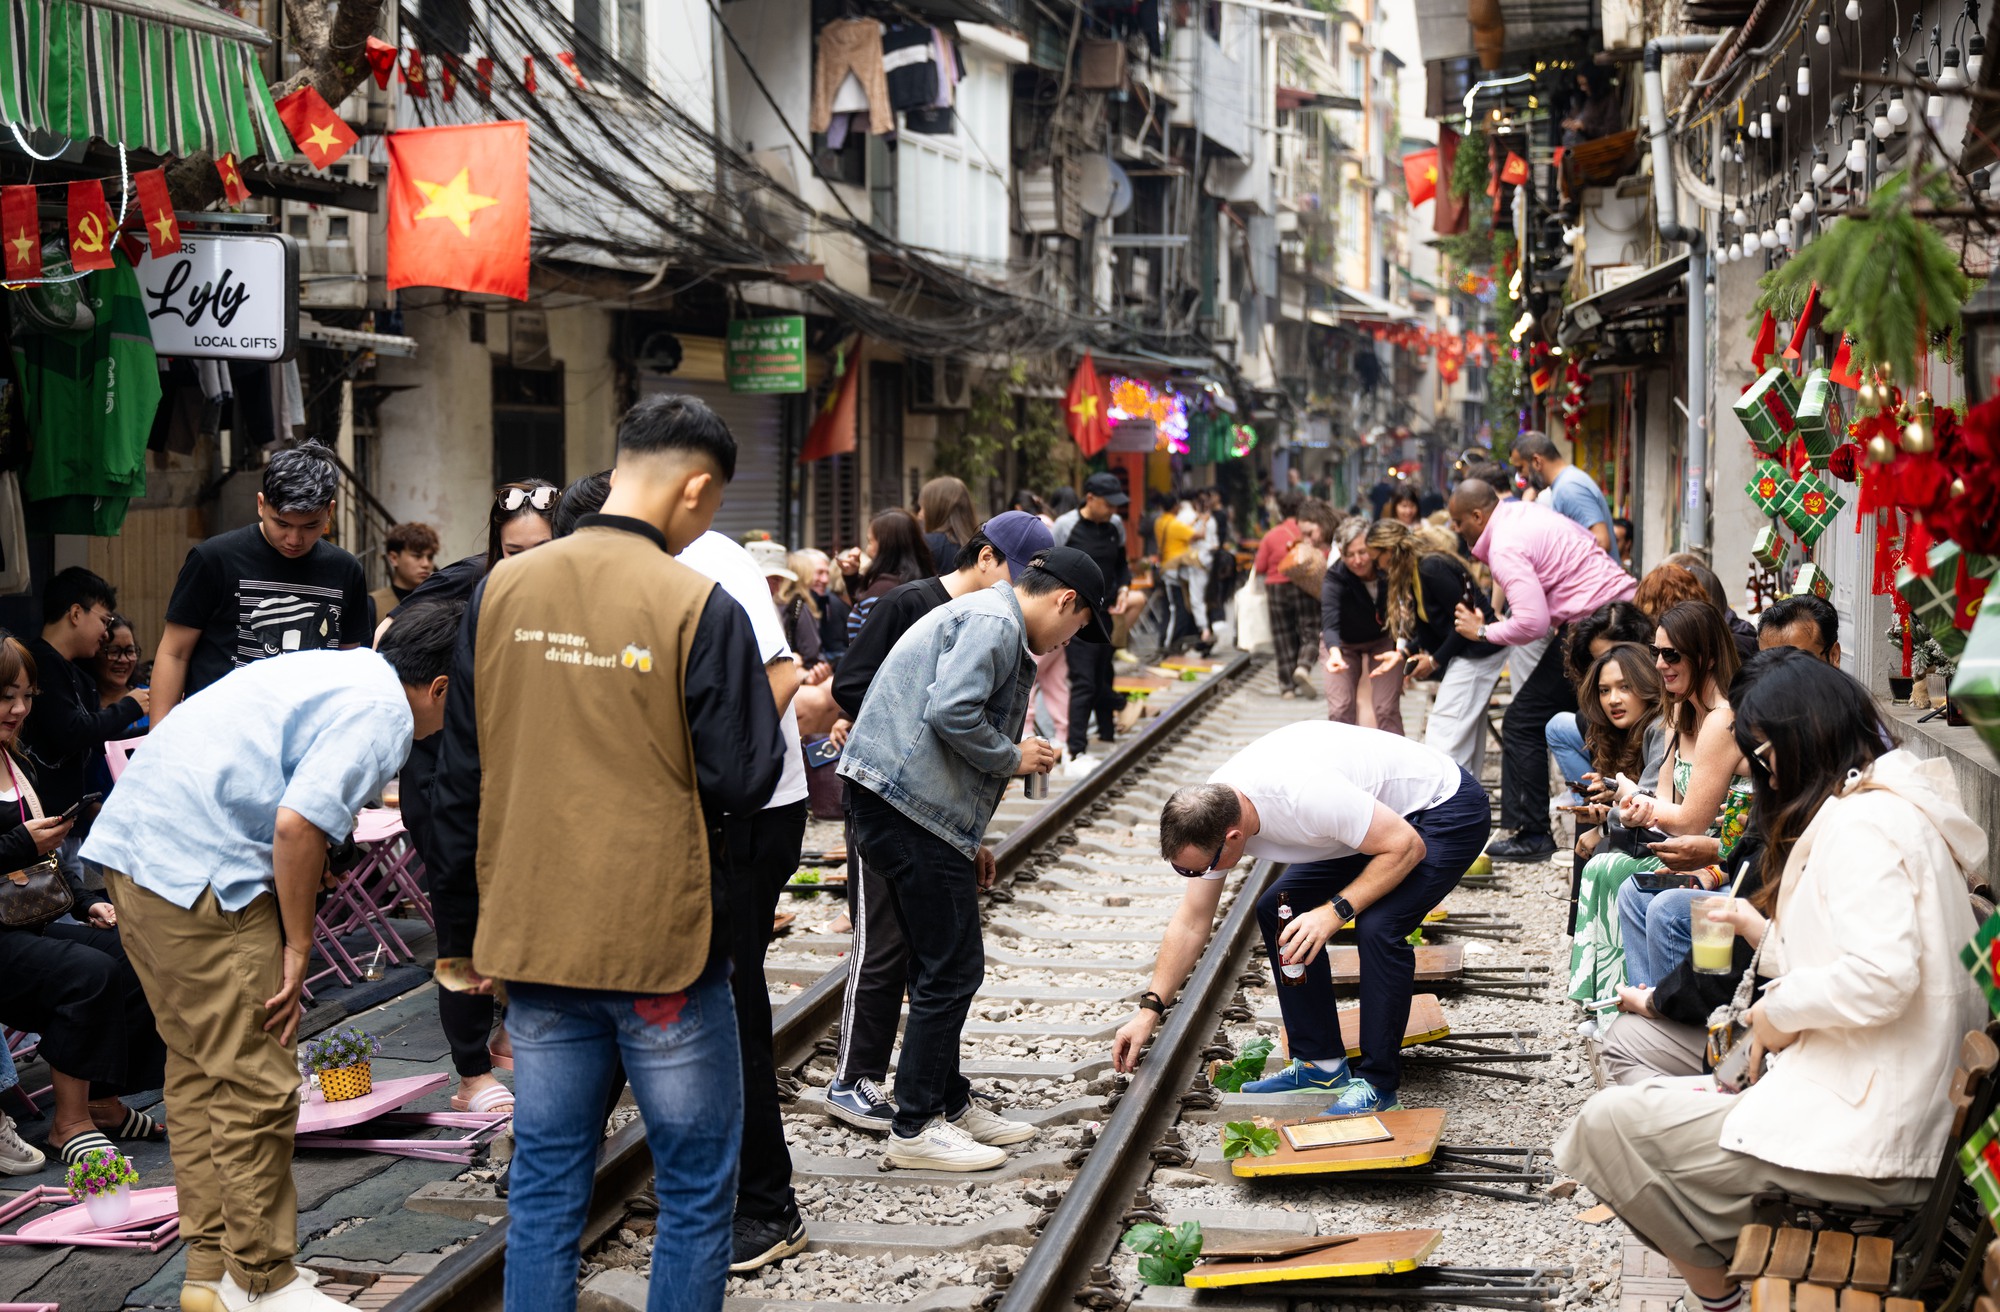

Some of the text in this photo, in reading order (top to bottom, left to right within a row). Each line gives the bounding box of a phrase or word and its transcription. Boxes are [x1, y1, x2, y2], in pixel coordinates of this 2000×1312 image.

[146, 259, 250, 328] Lyly
[194, 336, 277, 349] LOCAL GIFTS
[514, 628, 589, 649] Save water,
[545, 646, 617, 668] drink Beer!
[28, 793, 42, 819] VUITTO
